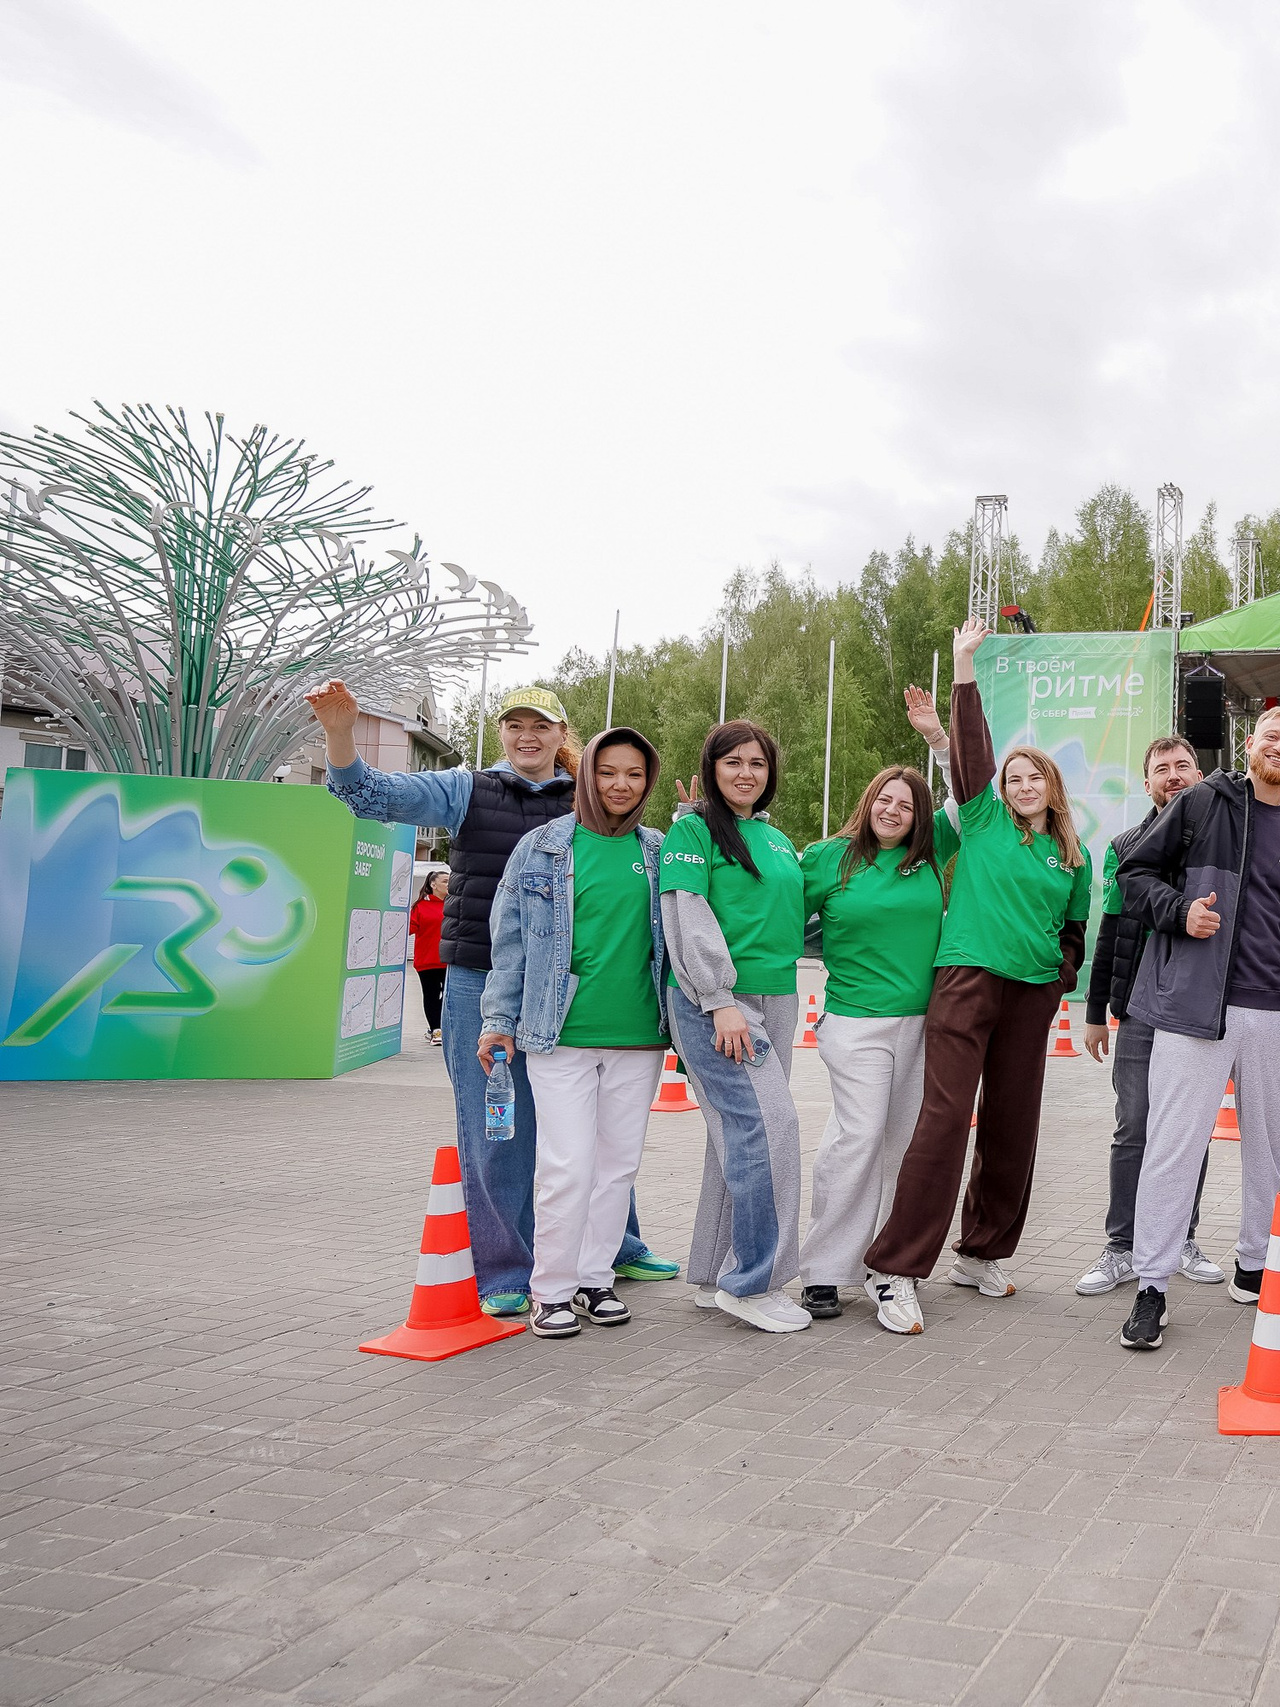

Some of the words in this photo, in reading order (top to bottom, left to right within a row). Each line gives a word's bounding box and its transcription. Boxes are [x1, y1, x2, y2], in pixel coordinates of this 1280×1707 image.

[996, 656, 1009, 673] В
[1015, 656, 1076, 673] твоём
[1030, 672, 1145, 706] ритме
[507, 690, 551, 709] RUSSIA
[1042, 709, 1068, 718] СБЕР
[356, 840, 386, 861] ВЗРОСЛЫЙ
[354, 861, 372, 877] ЗАБЕГ
